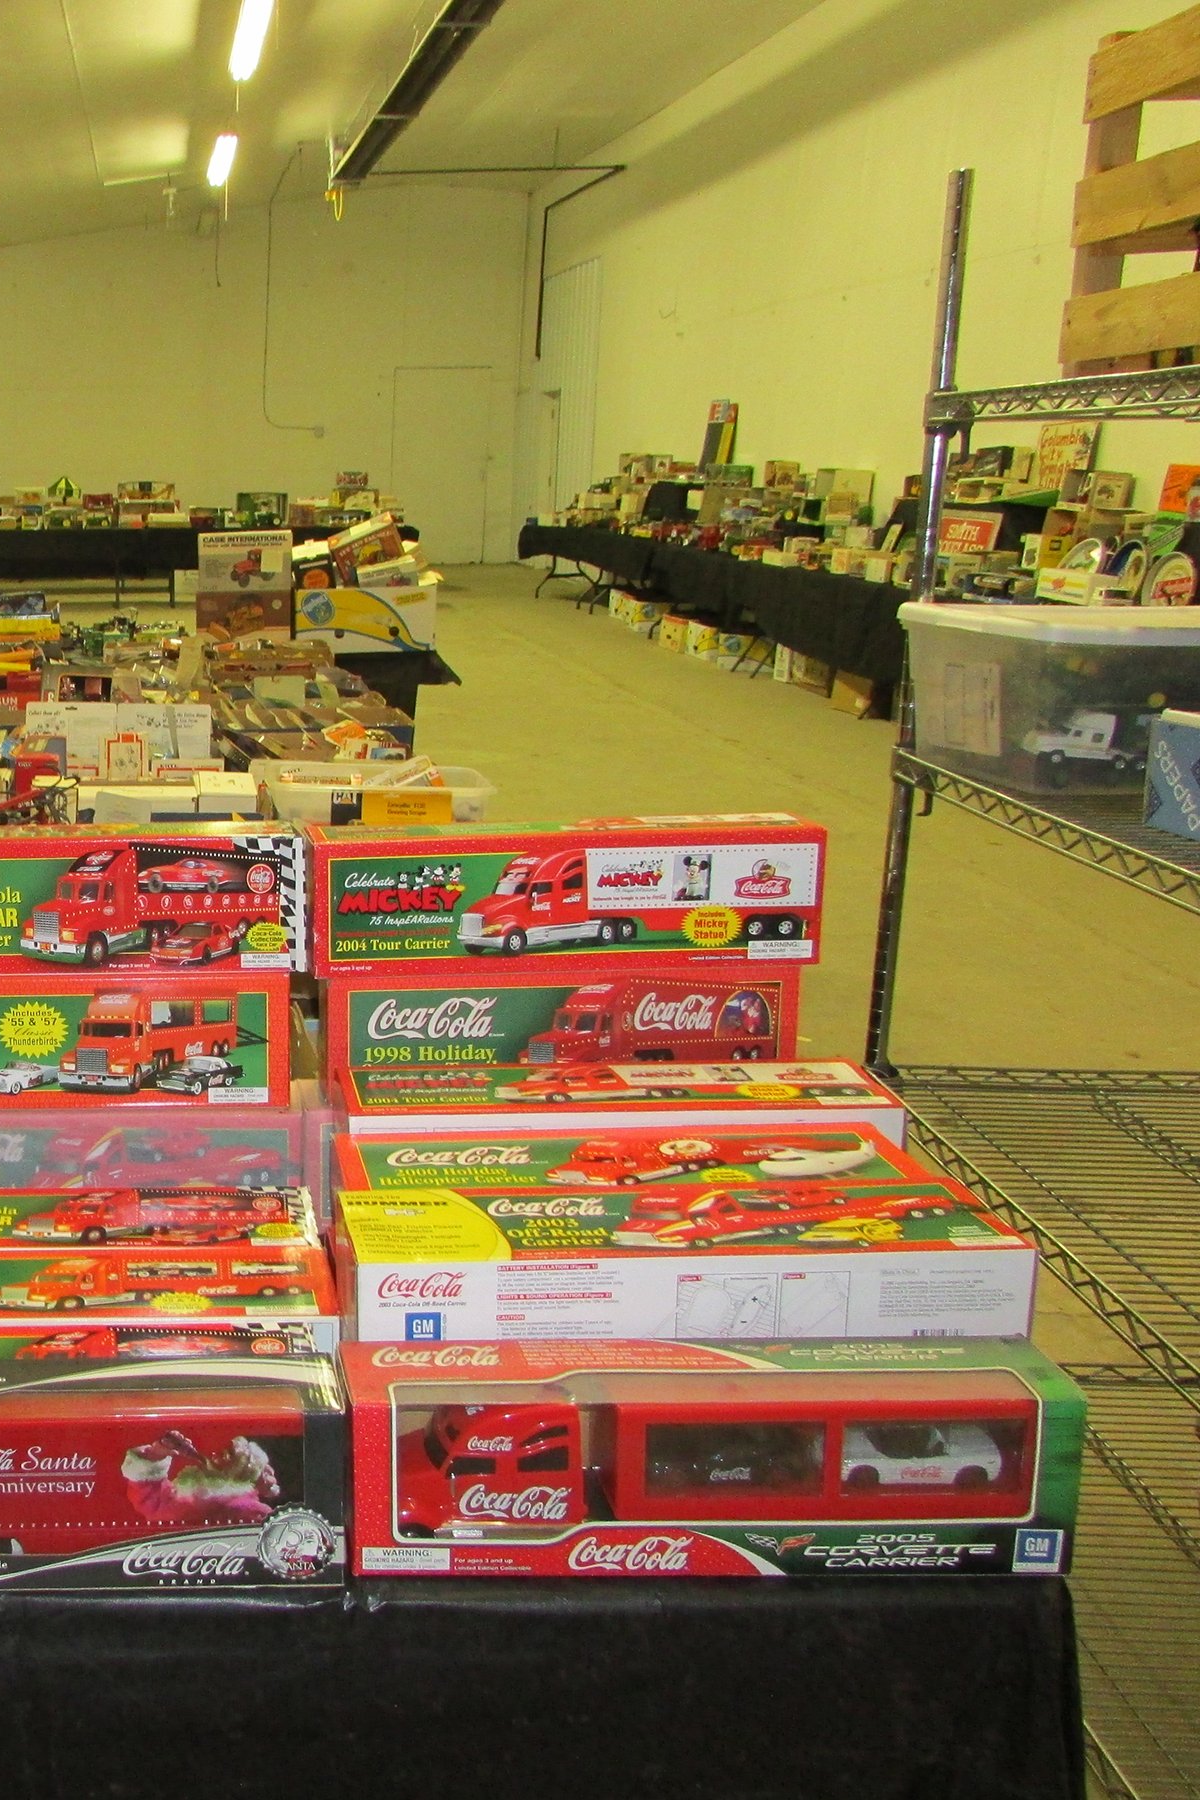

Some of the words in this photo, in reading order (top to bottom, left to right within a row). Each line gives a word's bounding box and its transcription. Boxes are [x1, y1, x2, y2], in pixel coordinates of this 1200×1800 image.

[345, 873, 395, 888] Celebrate
[740, 879, 784, 894] Coca-Cola
[338, 887, 462, 915] MICKEY
[694, 919, 728, 929] Mickey
[694, 929, 728, 939] Statue!
[336, 938, 367, 952] 2004
[370, 939, 402, 951] Tour
[404, 938, 450, 950] Carrier
[367, 996, 497, 1040] Coca-Cola
[633, 992, 716, 1031] Coca-Cola
[7, 1018, 25, 1026] '55
[29, 1018, 38, 1026] &
[40, 1017, 57, 1026] '57
[9, 1037, 58, 1046] Thunderbirds
[363, 1047, 412, 1063] 1998
[418, 1044, 496, 1064] Holiday
[386, 1145, 531, 1167] Coca-Cola
[395, 1168, 439, 1177] 2000
[443, 1166, 508, 1177] Holiday
[379, 1176, 469, 1186] Helicopter
[474, 1175, 537, 1184] Carrier
[487, 1198, 606, 1217] Coca-Cola
[522, 1219, 579, 1228] 2003
[506, 1227, 609, 1239] Off-Road
[521, 1237, 604, 1247] Carrier
[378, 1271, 468, 1299] Coca-Cola
[413, 1319, 434, 1333] GM
[372, 1345, 501, 1367] Coca-Cola
[467, 1436, 513, 1451] Coca-Cola
[21, 1446, 97, 1471] Santa
[459, 1484, 572, 1520] Coca-Cola
[856, 1533, 937, 1544] 2005
[1025, 1537, 1049, 1552] GM
[382, 1549, 432, 1557] WARNING:
[568, 1535, 694, 1571] Coca-Cola
[803, 1543, 997, 1557] CORVETTE
[123, 1543, 249, 1576] Coca-Cola
[825, 1557, 960, 1568] CARRIER
